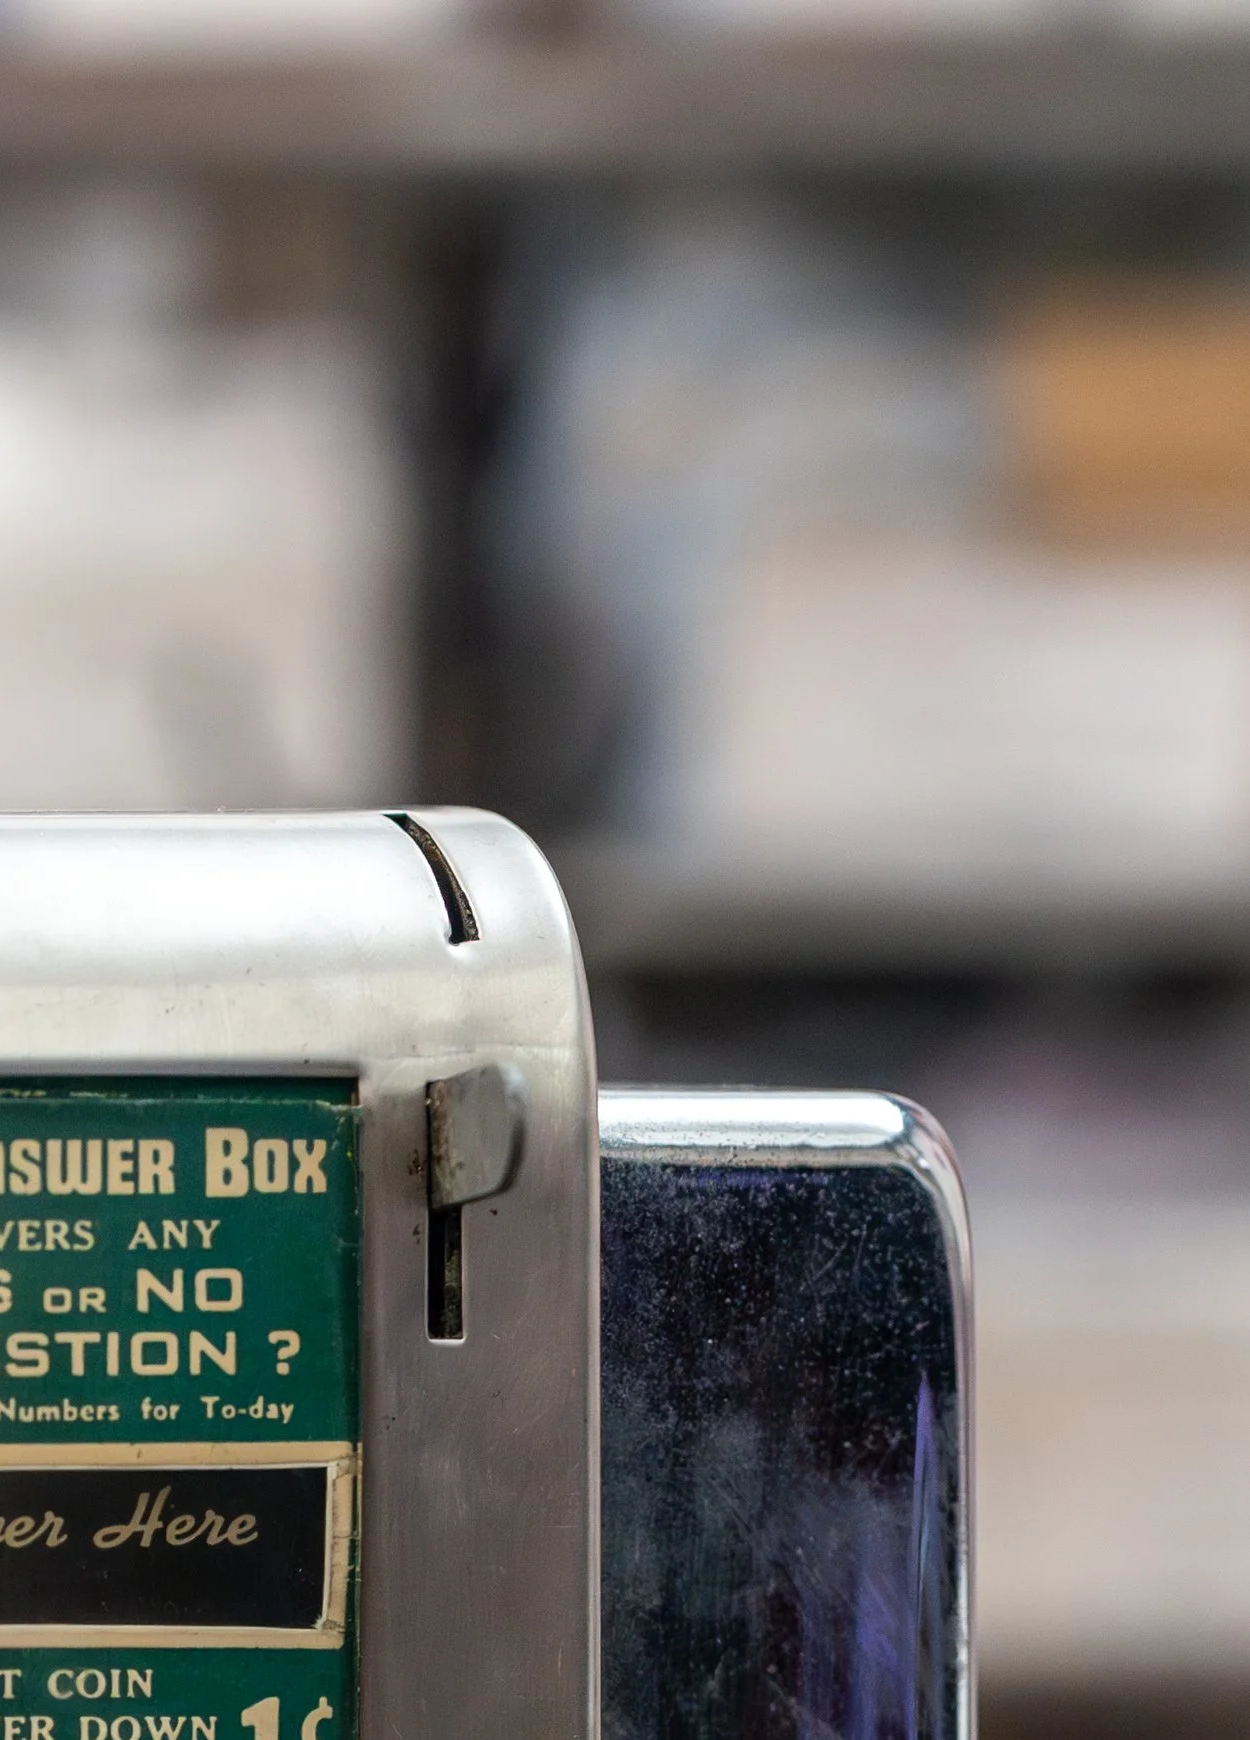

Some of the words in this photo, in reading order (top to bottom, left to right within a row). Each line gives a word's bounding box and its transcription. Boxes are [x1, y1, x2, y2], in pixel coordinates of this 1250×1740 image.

[206, 1128, 326, 1197] BOX
[129, 1220, 219, 1249] ANY
[44, 1288, 105, 1313] OR
[137, 1269, 242, 1312] NO
[142, 1398, 179, 1420] for
[201, 1397, 293, 1423] To-day
[93, 1487, 257, 1548] Here
[48, 1669, 152, 1699] COIN
